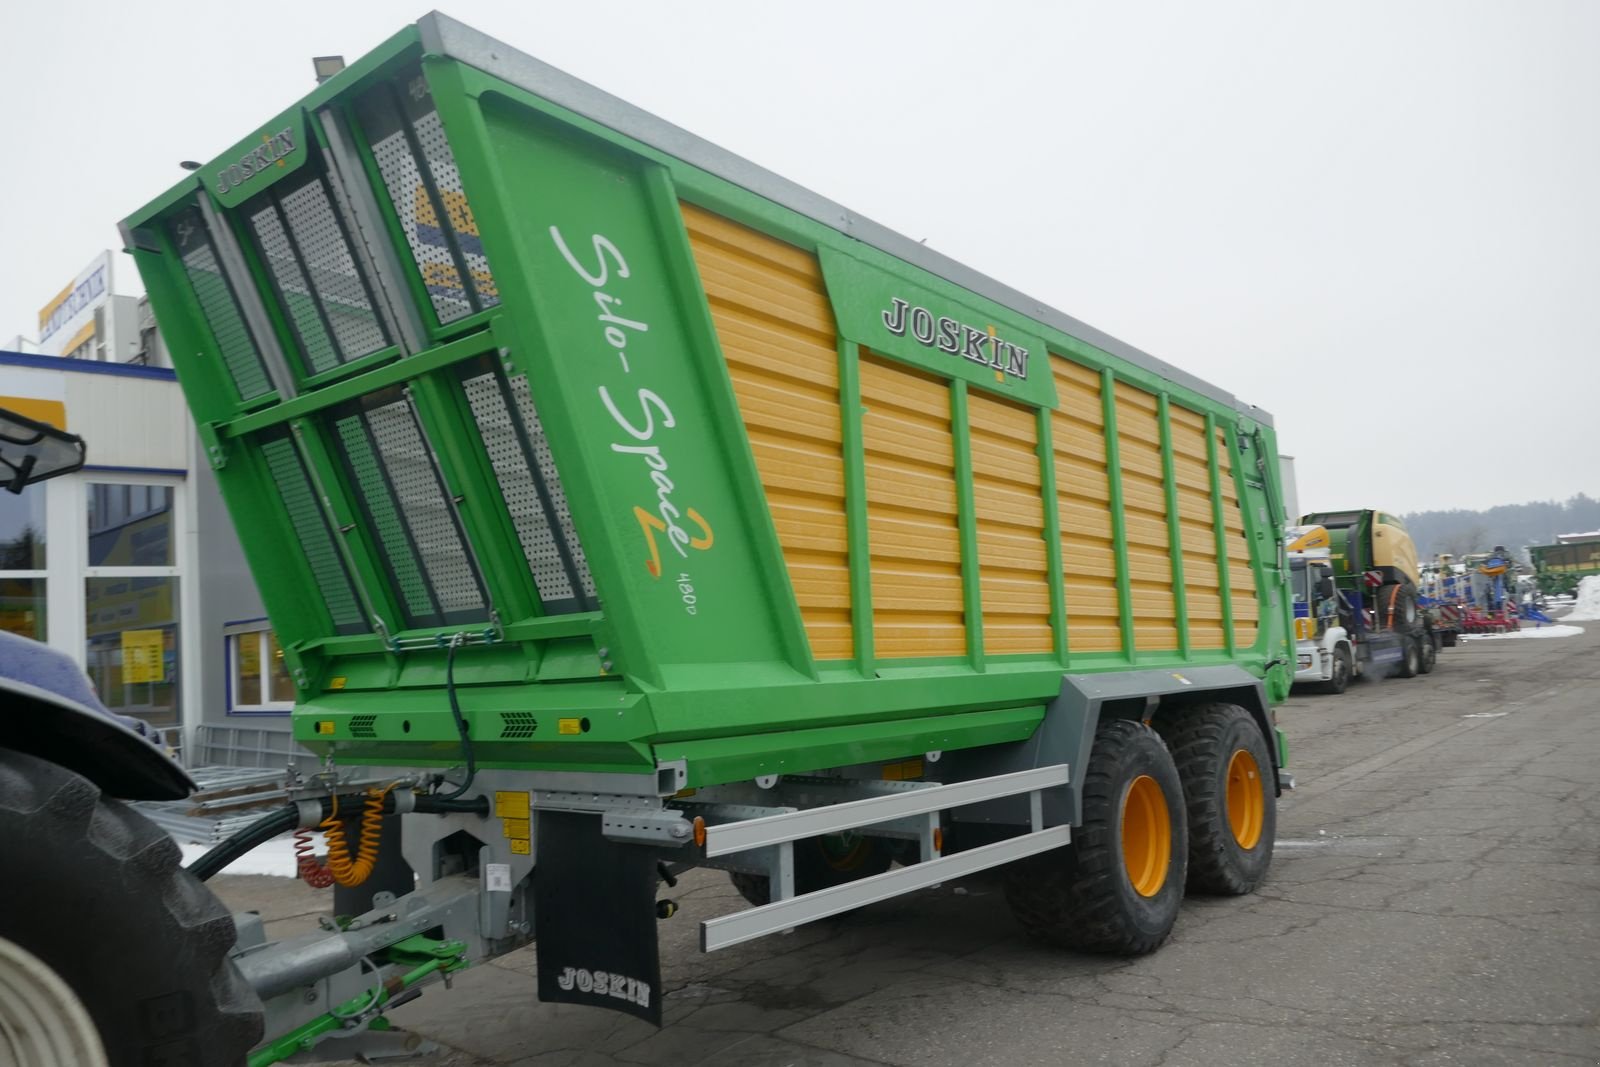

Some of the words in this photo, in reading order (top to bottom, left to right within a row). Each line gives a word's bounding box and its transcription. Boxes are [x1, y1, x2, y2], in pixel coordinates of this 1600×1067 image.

[215, 127, 296, 194] JOSKIN
[882, 297, 1029, 380] JOSKIN
[557, 967, 650, 1008] JOSKIN
